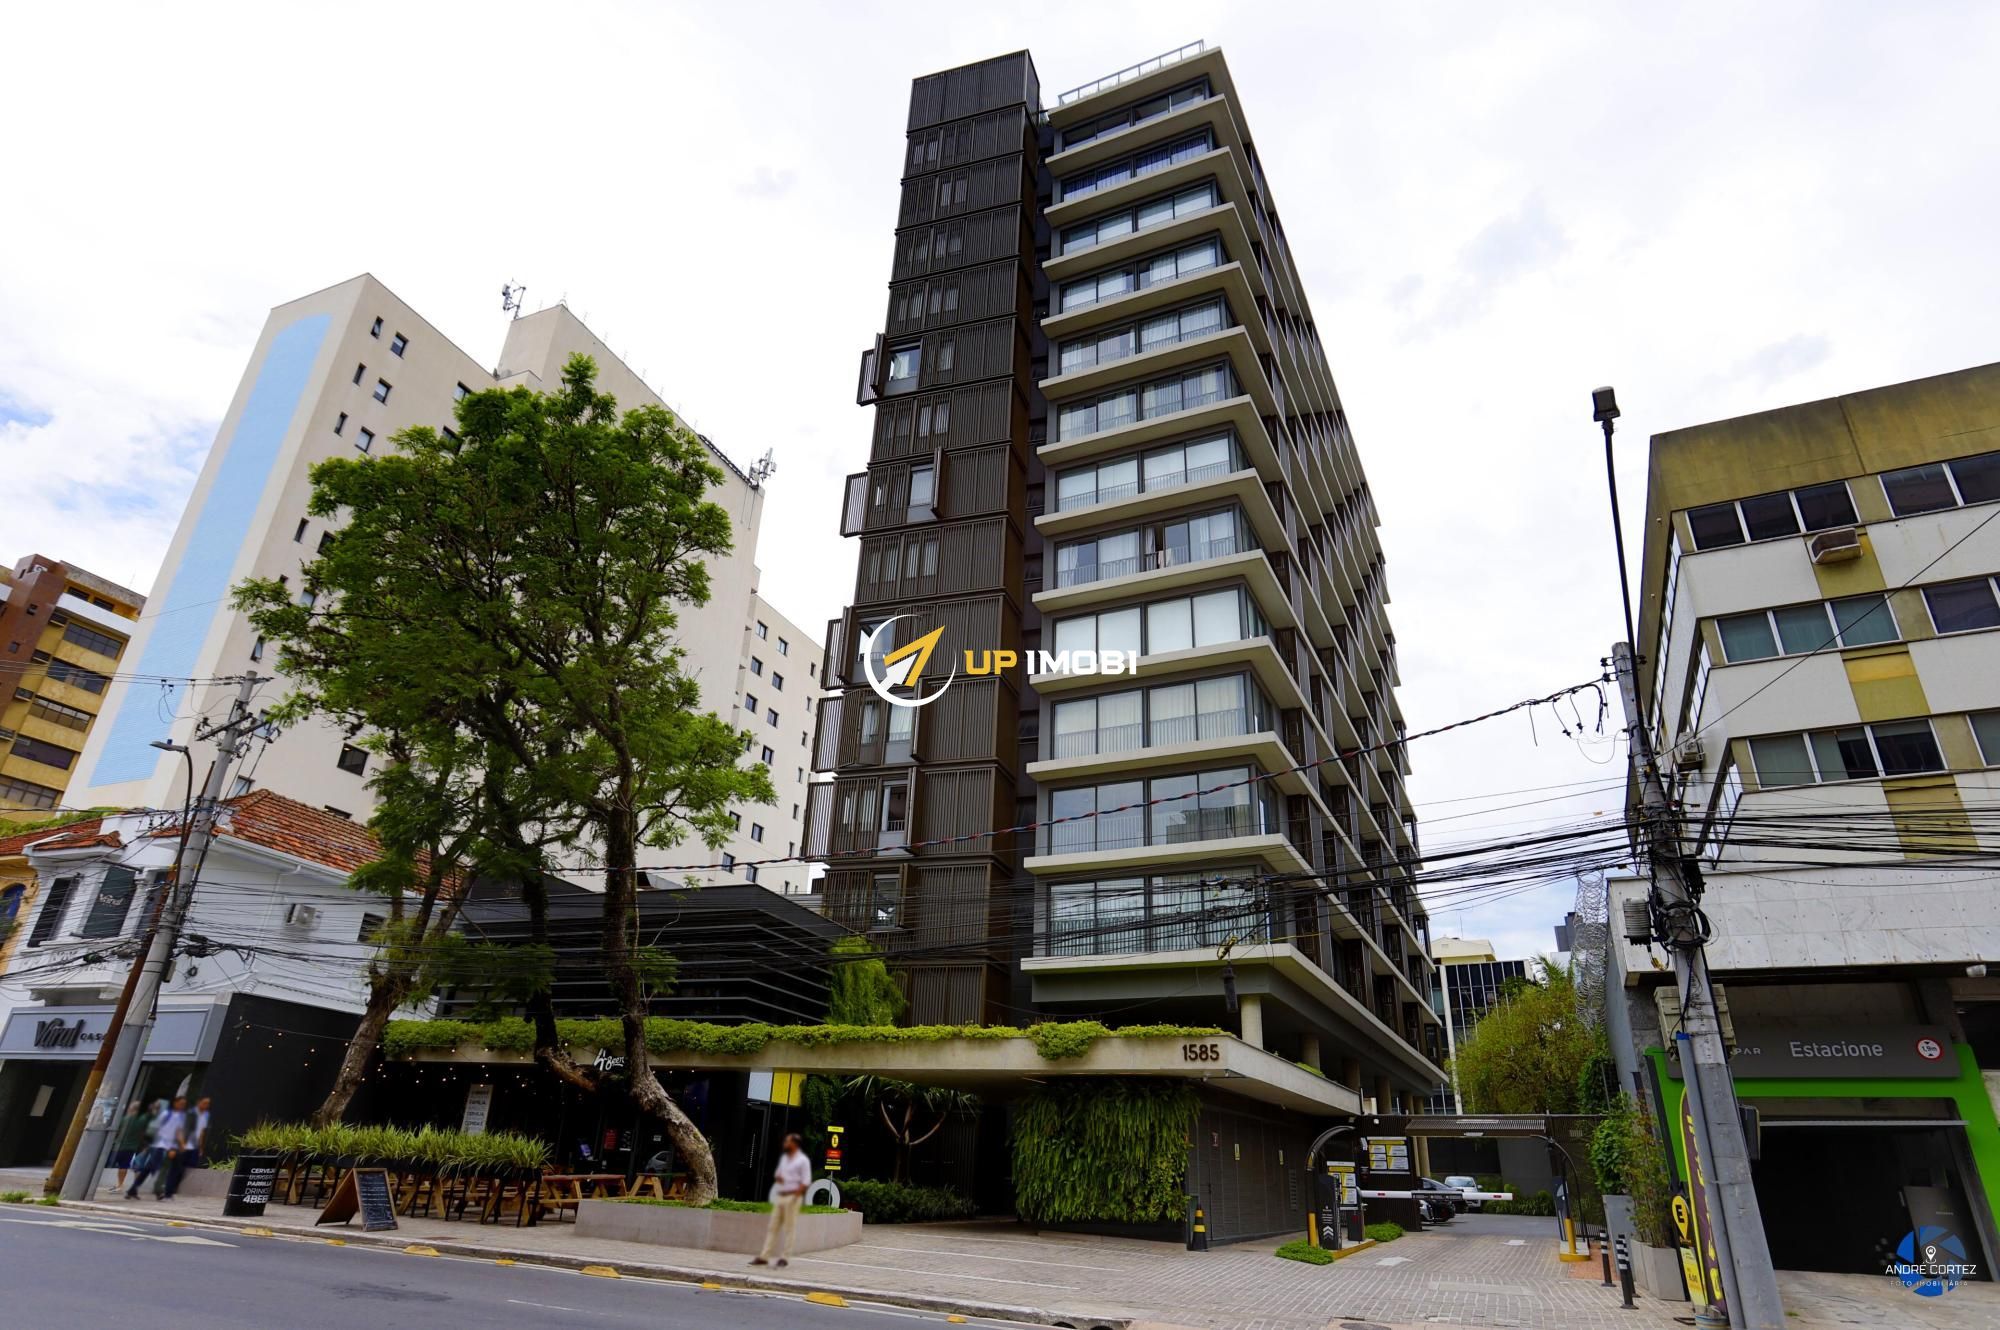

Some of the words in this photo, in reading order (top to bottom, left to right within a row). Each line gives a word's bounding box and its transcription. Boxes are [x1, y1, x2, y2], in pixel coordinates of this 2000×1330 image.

[1182, 1044, 1220, 1061] 1585
[1789, 1041, 1884, 1058] Estacione
[1675, 1204, 1686, 1224] E
